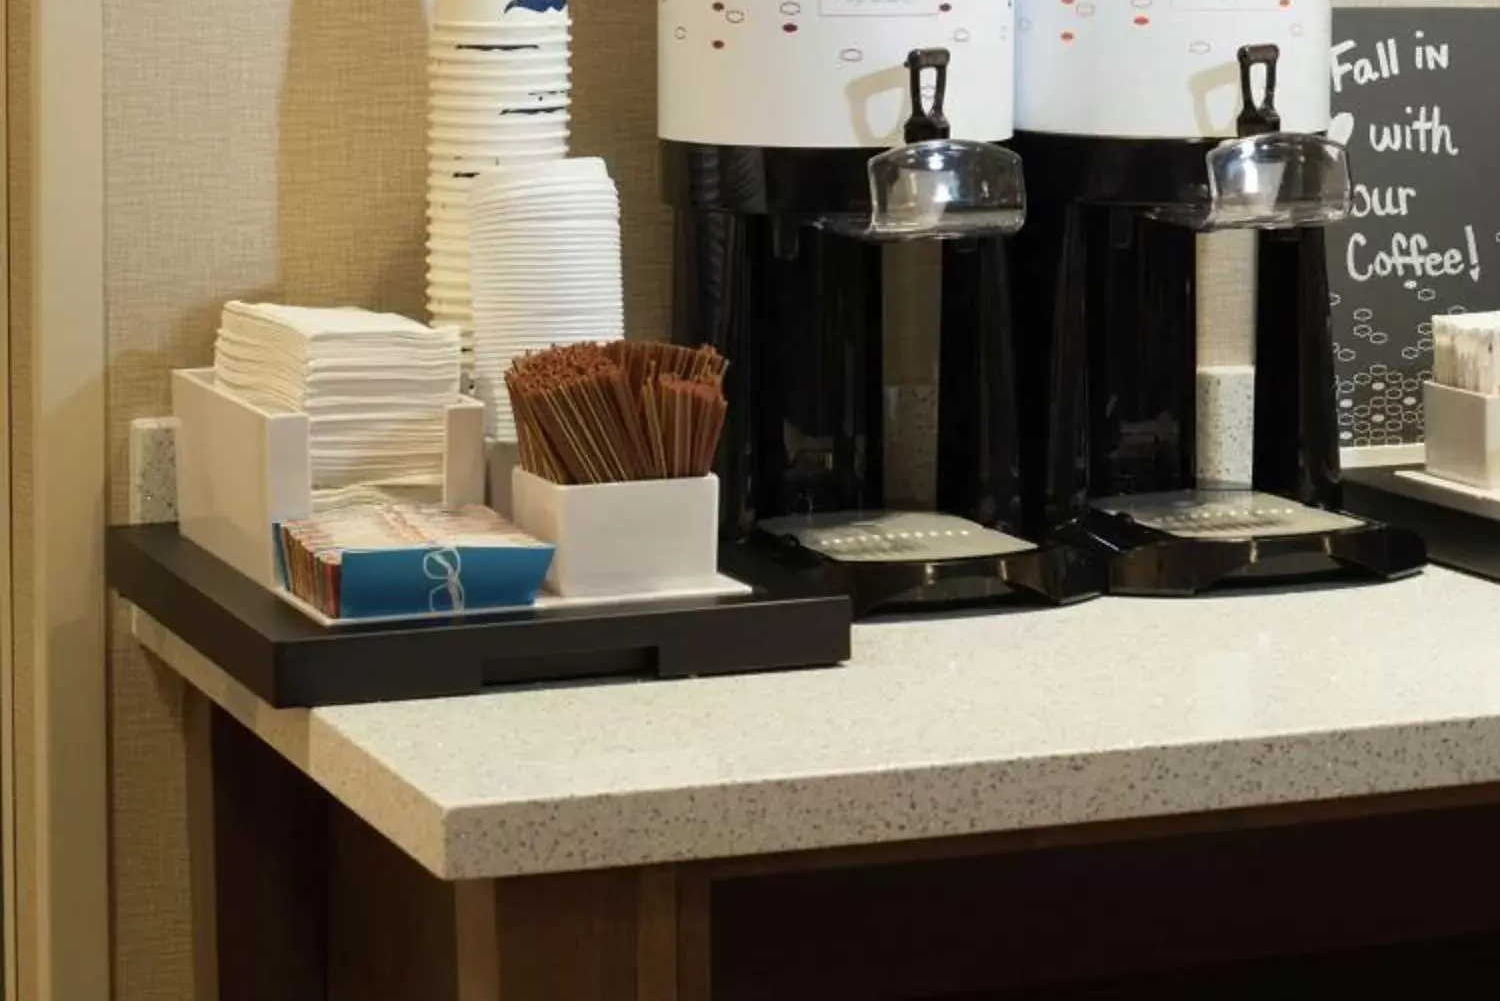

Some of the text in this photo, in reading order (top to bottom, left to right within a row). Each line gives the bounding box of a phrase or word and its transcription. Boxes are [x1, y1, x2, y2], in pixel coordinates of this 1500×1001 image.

[1330, 37, 1399, 93] Fall
[1369, 105, 1459, 156] with
[1346, 224, 1481, 283] Coffee!
